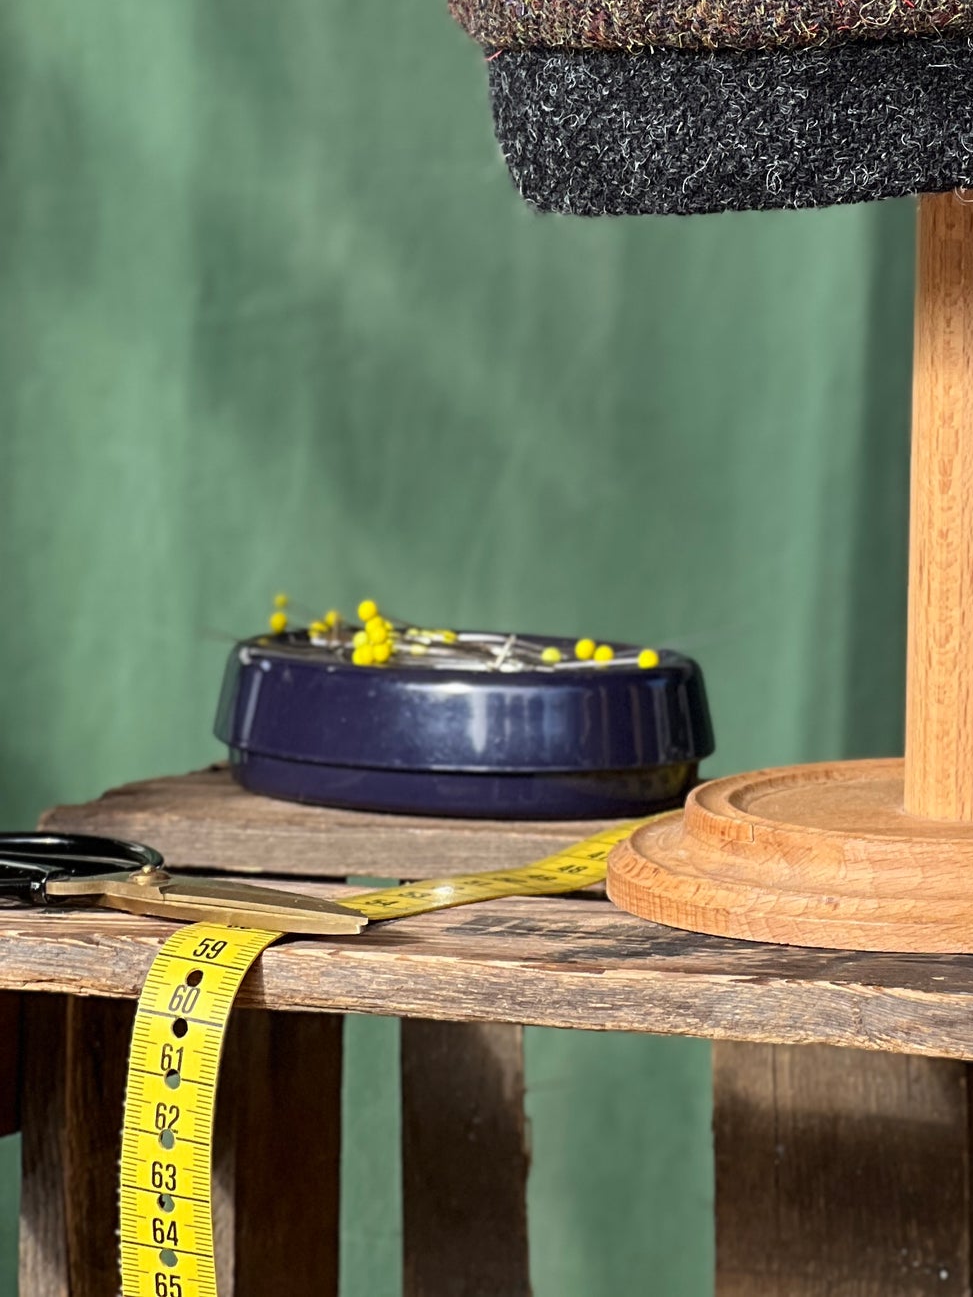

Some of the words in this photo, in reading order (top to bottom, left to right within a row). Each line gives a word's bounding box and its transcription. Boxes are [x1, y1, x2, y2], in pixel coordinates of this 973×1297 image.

[193, 938, 228, 959] 59
[168, 984, 201, 1014] 60
[160, 1043, 184, 1072] 61
[154, 1102, 180, 1134] 62
[151, 1160, 177, 1192] 63
[152, 1217, 179, 1247] 64
[154, 1272, 183, 1297] 65
